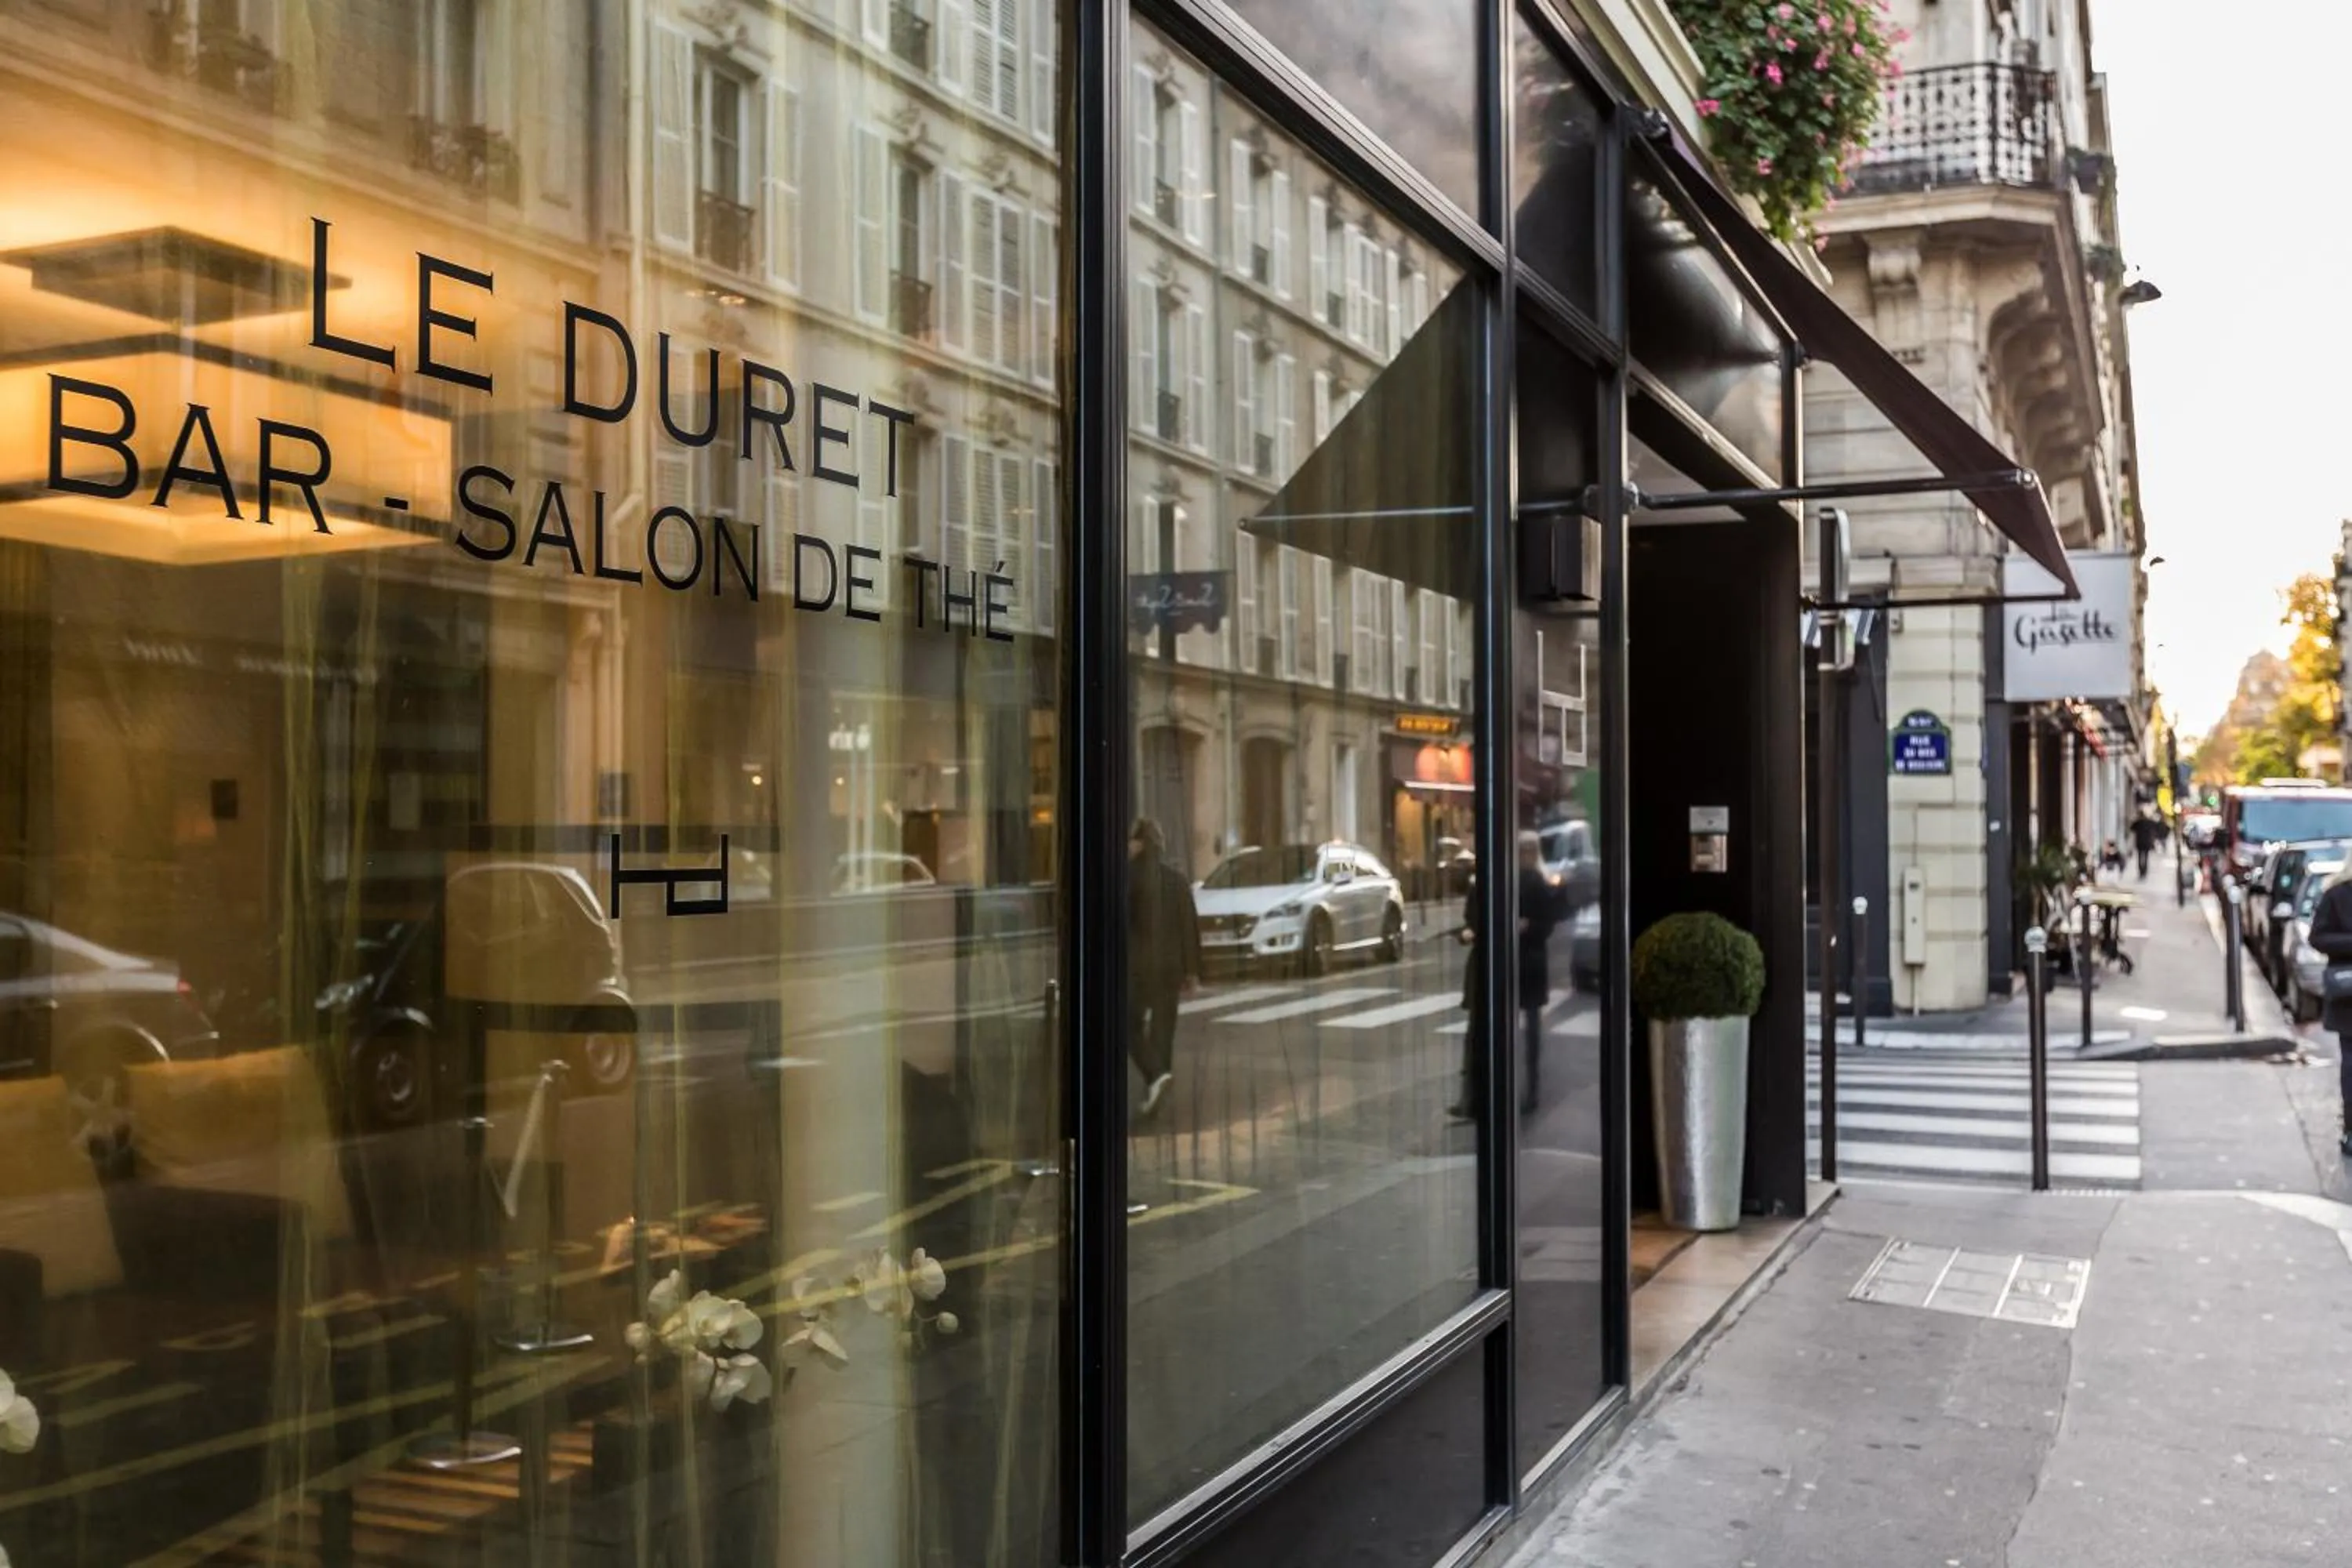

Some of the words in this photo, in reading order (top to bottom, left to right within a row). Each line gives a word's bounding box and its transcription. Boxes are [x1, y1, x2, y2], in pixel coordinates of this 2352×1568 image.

[309, 216, 493, 397] LE
[562, 301, 915, 498] DURET
[47, 372, 334, 535] BAR
[455, 465, 760, 602] SALON
[793, 533, 881, 622] DE
[904, 554, 1014, 643] THÉ
